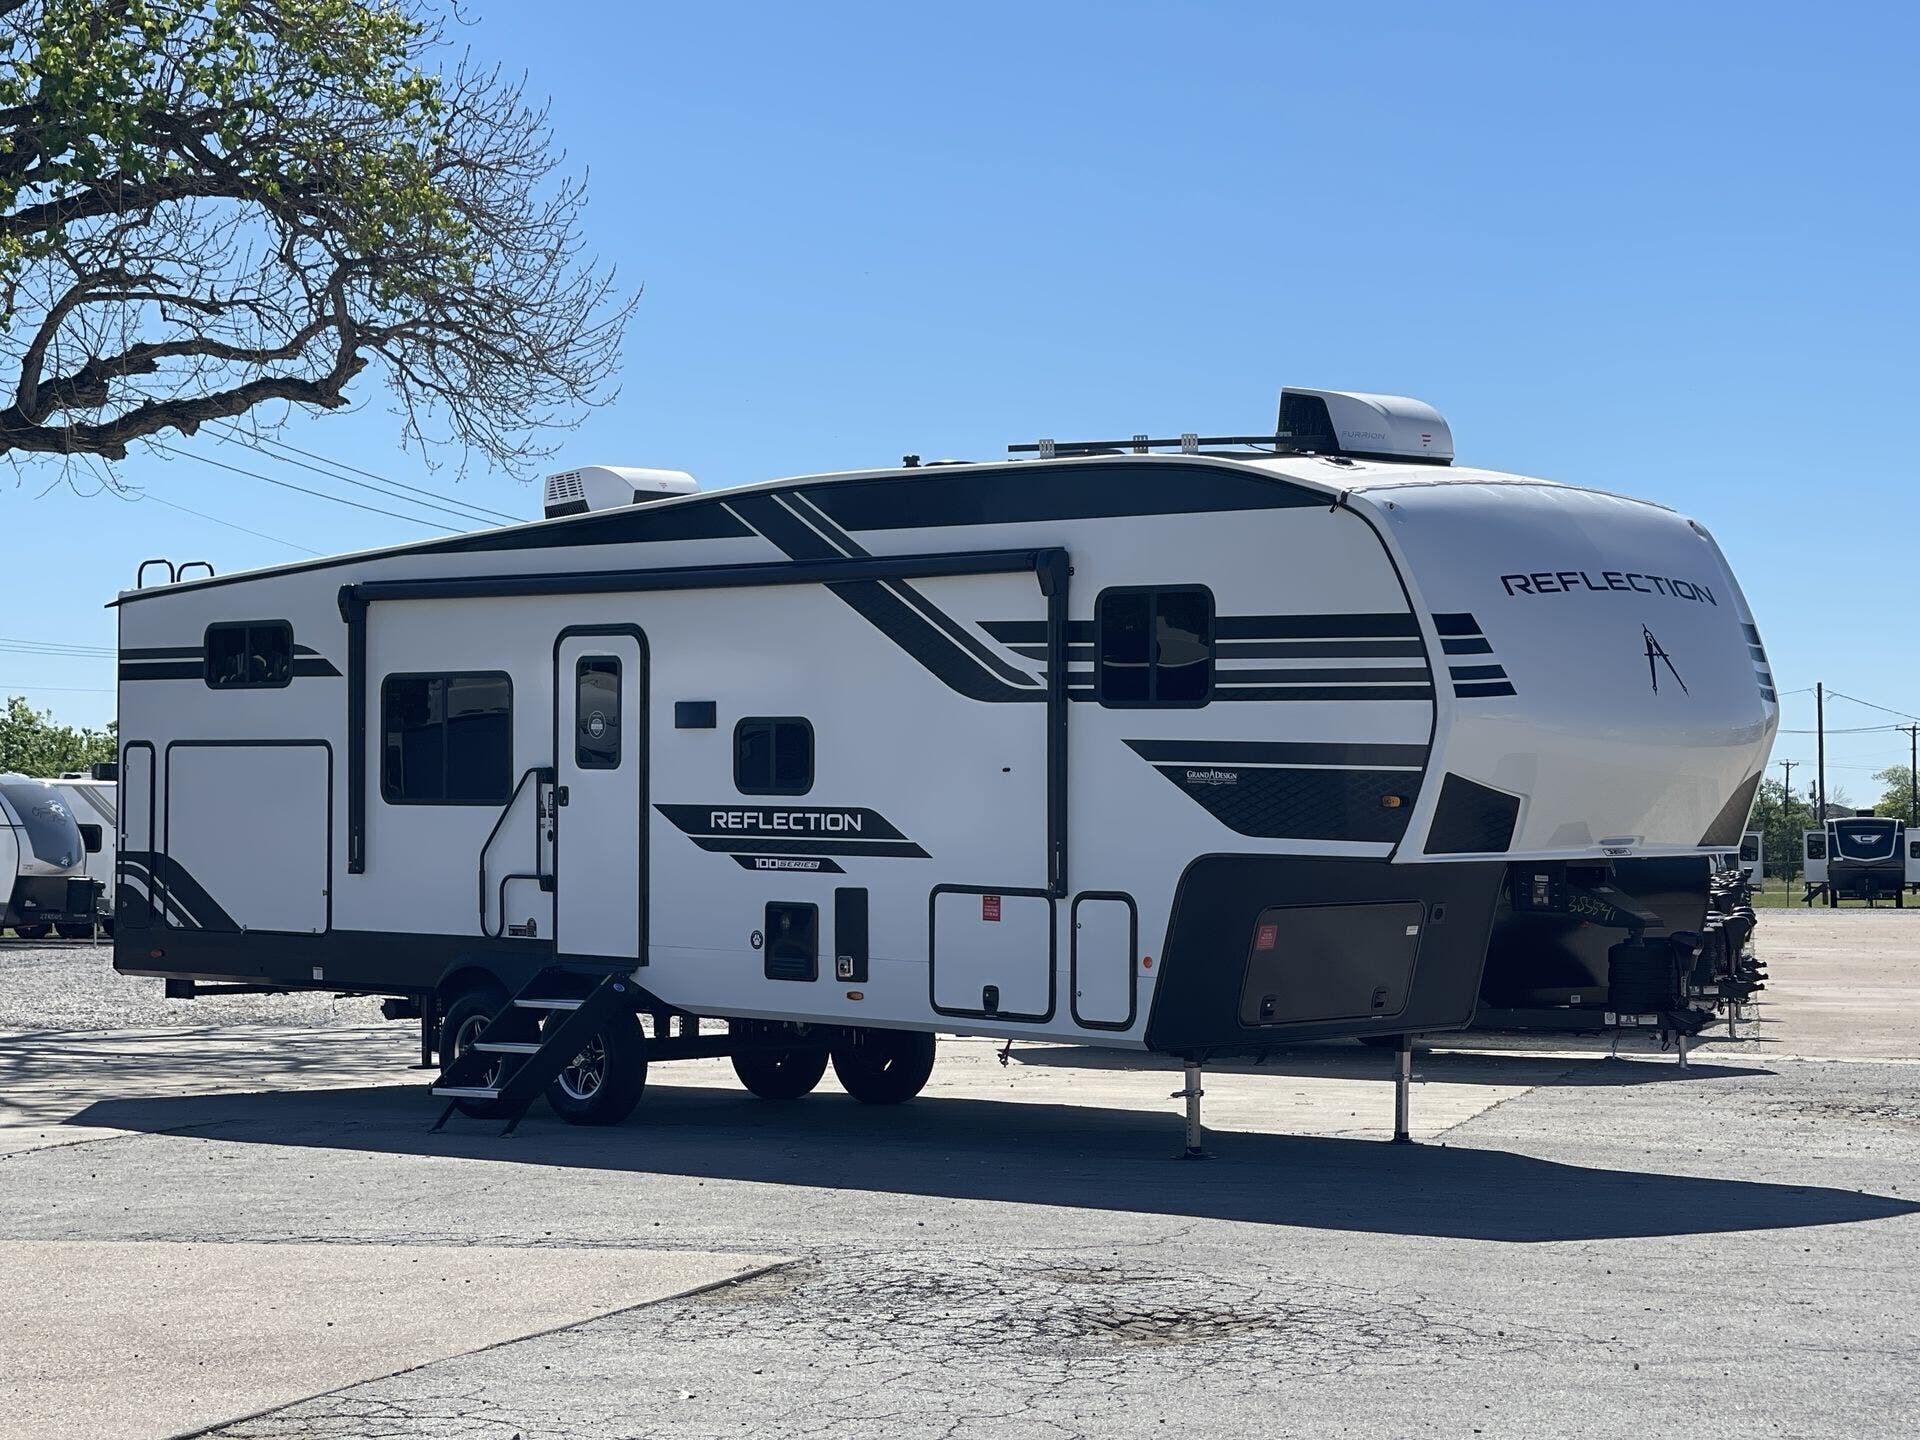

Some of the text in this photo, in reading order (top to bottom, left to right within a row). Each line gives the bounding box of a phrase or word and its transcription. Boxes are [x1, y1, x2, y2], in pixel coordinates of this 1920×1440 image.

[1341, 430, 1386, 440] FURRION
[1500, 571, 1718, 606] REFLECTION
[710, 811, 862, 832] REFLECTION
[754, 858, 820, 870] 100 SERIES
